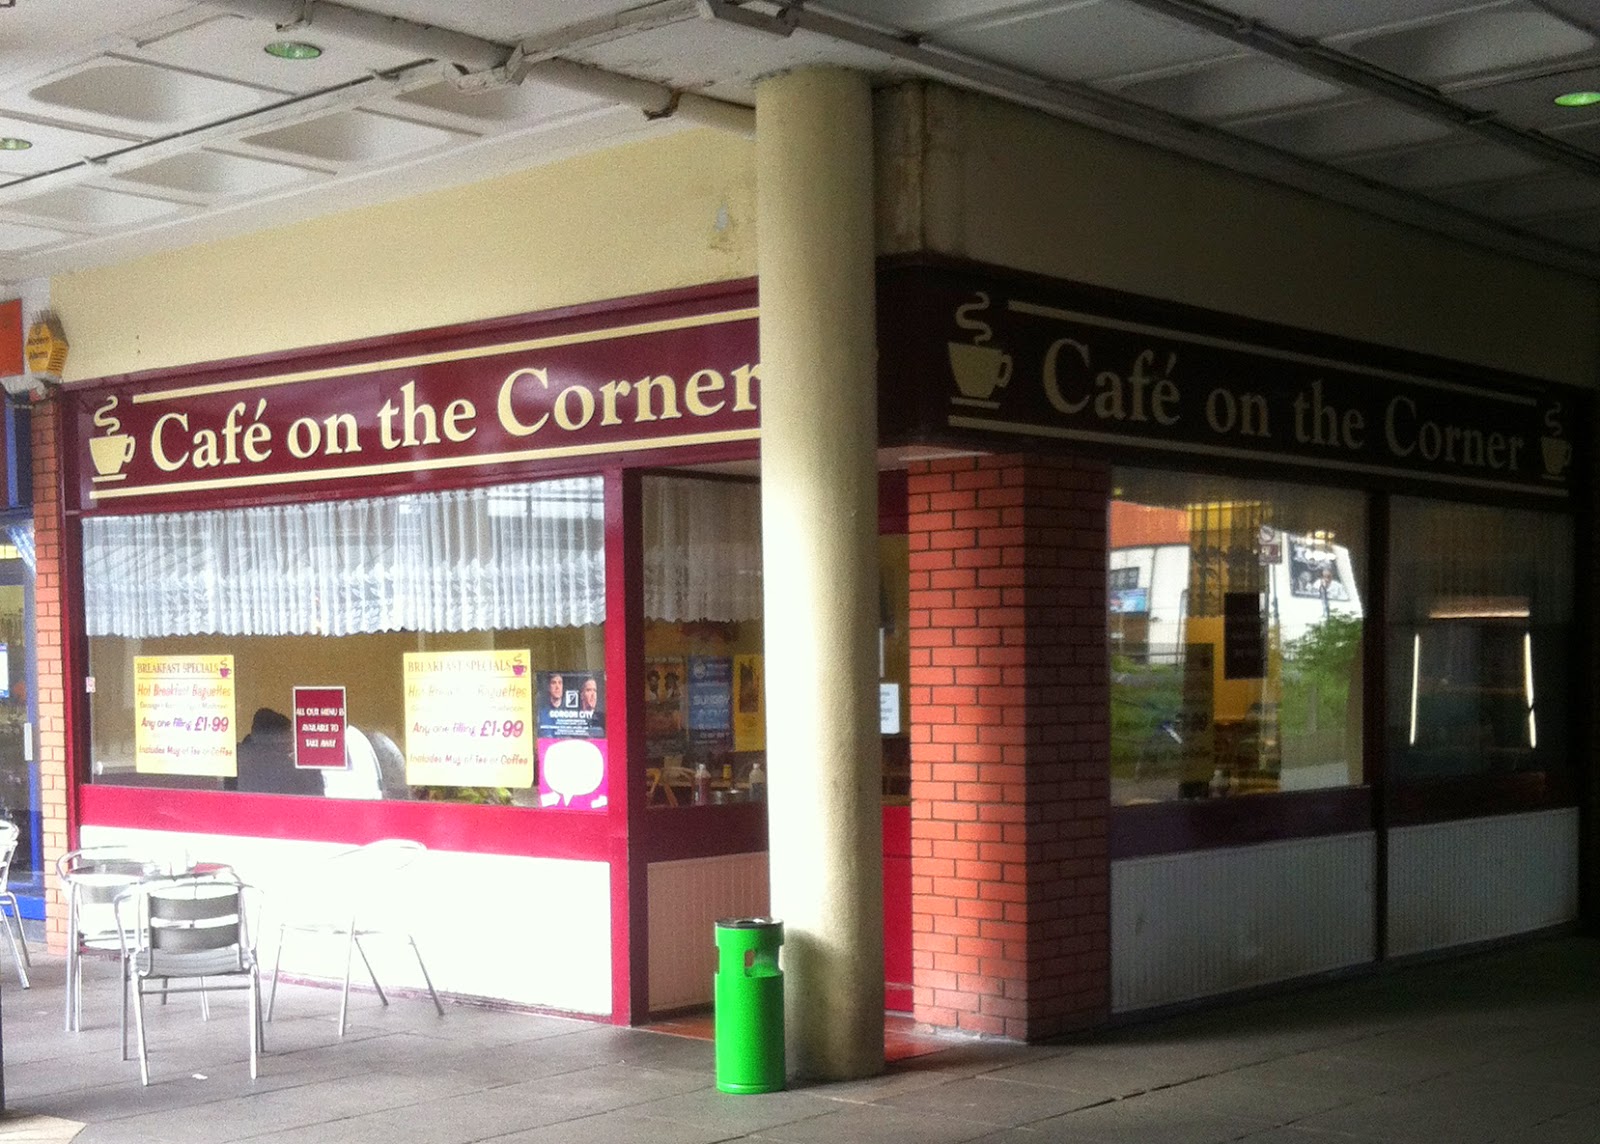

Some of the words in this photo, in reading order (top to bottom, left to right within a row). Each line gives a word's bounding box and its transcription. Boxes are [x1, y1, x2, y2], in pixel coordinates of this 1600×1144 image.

[1043, 338, 1181, 425] Café
[1206, 388, 1272, 438] on
[1294, 379, 1365, 450] the
[1385, 395, 1525, 471] Corner
[151, 398, 272, 472] Café
[287, 411, 361, 459] on
[378, 381, 477, 454] the
[497, 362, 761, 436] Corner
[137, 662, 180, 674] BREAKFAST
[183, 662, 219, 674] SPECIALS
[407, 660, 462, 672] BREAKFAST
[465, 659, 512, 672] SPECIALS
[306, 707, 319, 716] OUR
[321, 707, 338, 717] MENU
[579, 709, 595, 719] CITY
[141, 716, 156, 731] Any
[157, 719, 171, 728] one
[302, 723, 330, 732] AVAILABLE
[331, 724, 340, 732] TO
[412, 721, 430, 736] Any
[432, 724, 449, 734] one
[305, 739, 318, 748] TAKE
[320, 739, 337, 748] AWAY
[167, 745, 181, 757] Mug
[445, 754, 462, 767] Mug
[500, 753, 529, 766] Coffee
